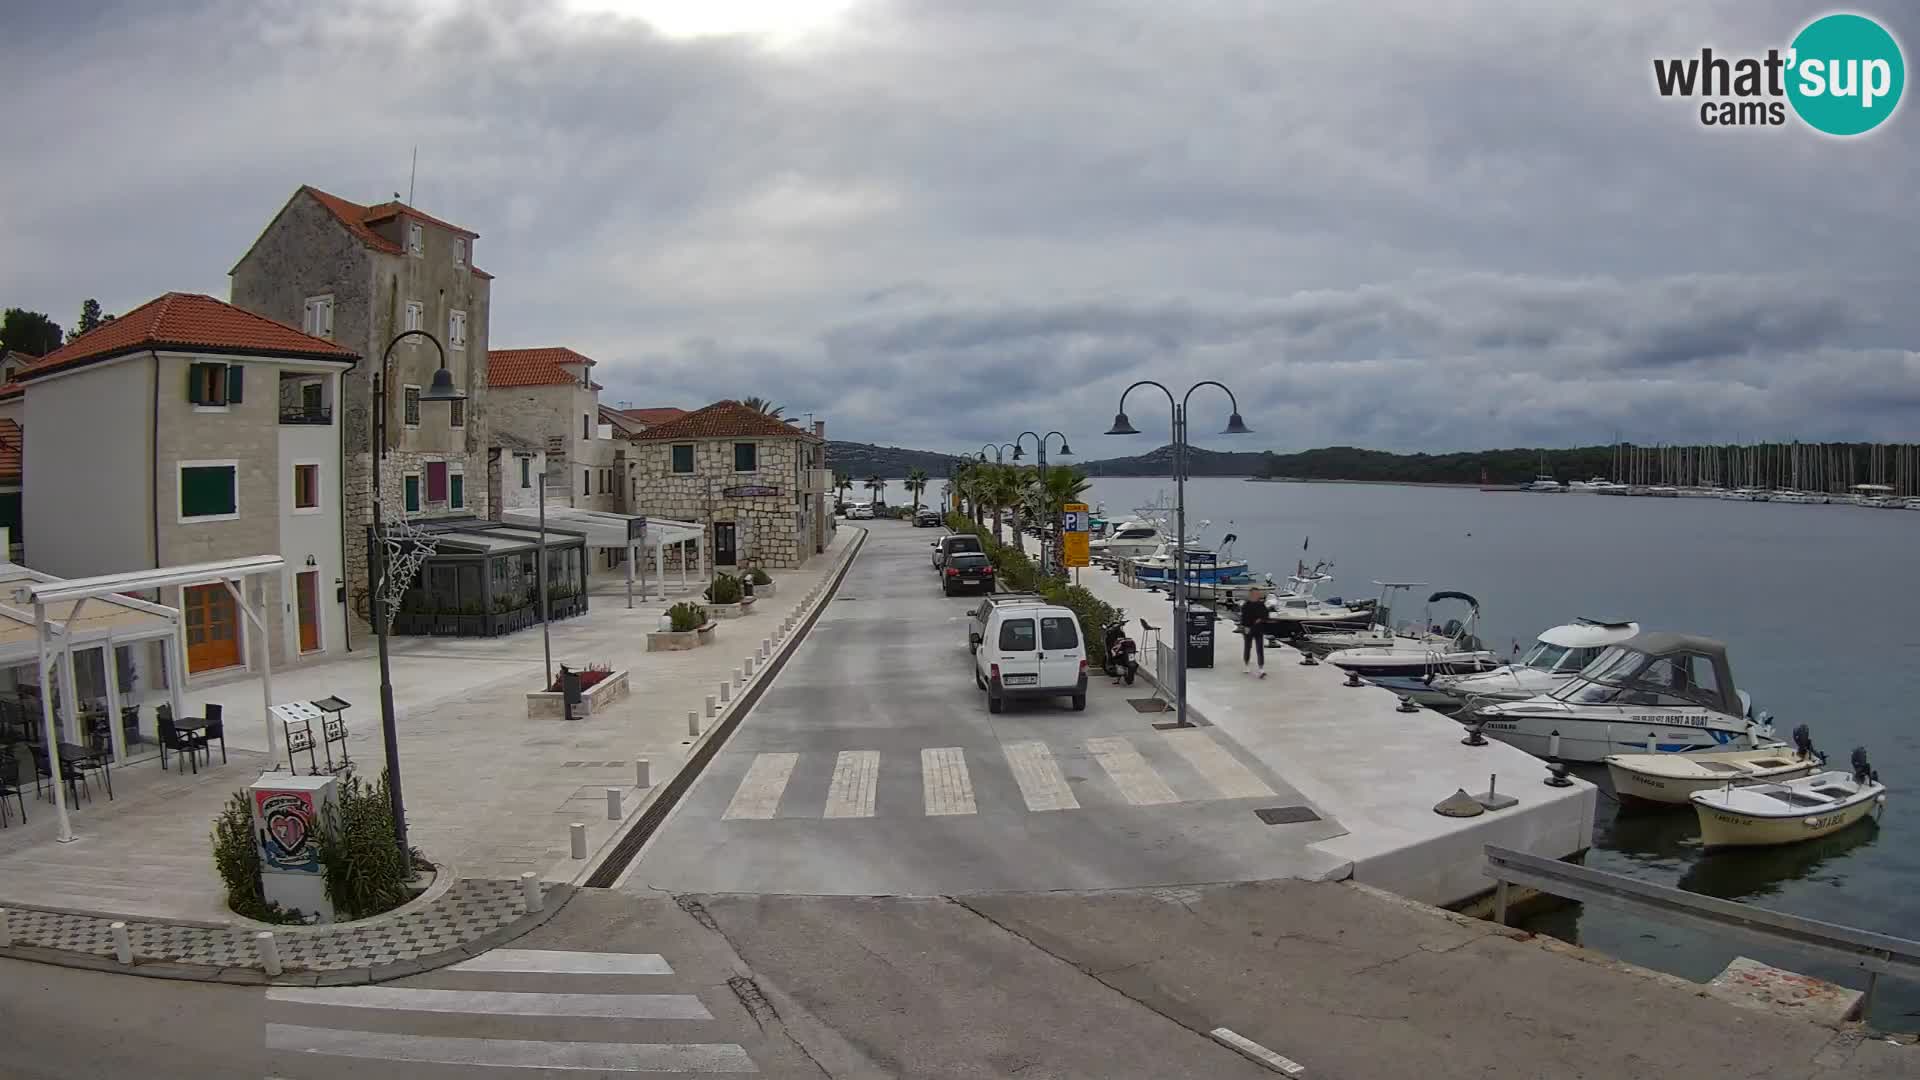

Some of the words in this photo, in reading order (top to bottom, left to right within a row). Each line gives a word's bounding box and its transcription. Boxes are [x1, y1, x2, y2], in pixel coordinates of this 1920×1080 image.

[1066, 514, 1076, 529] P
[1665, 715, 1684, 725] RENT
[1685, 716, 1690, 725] A
